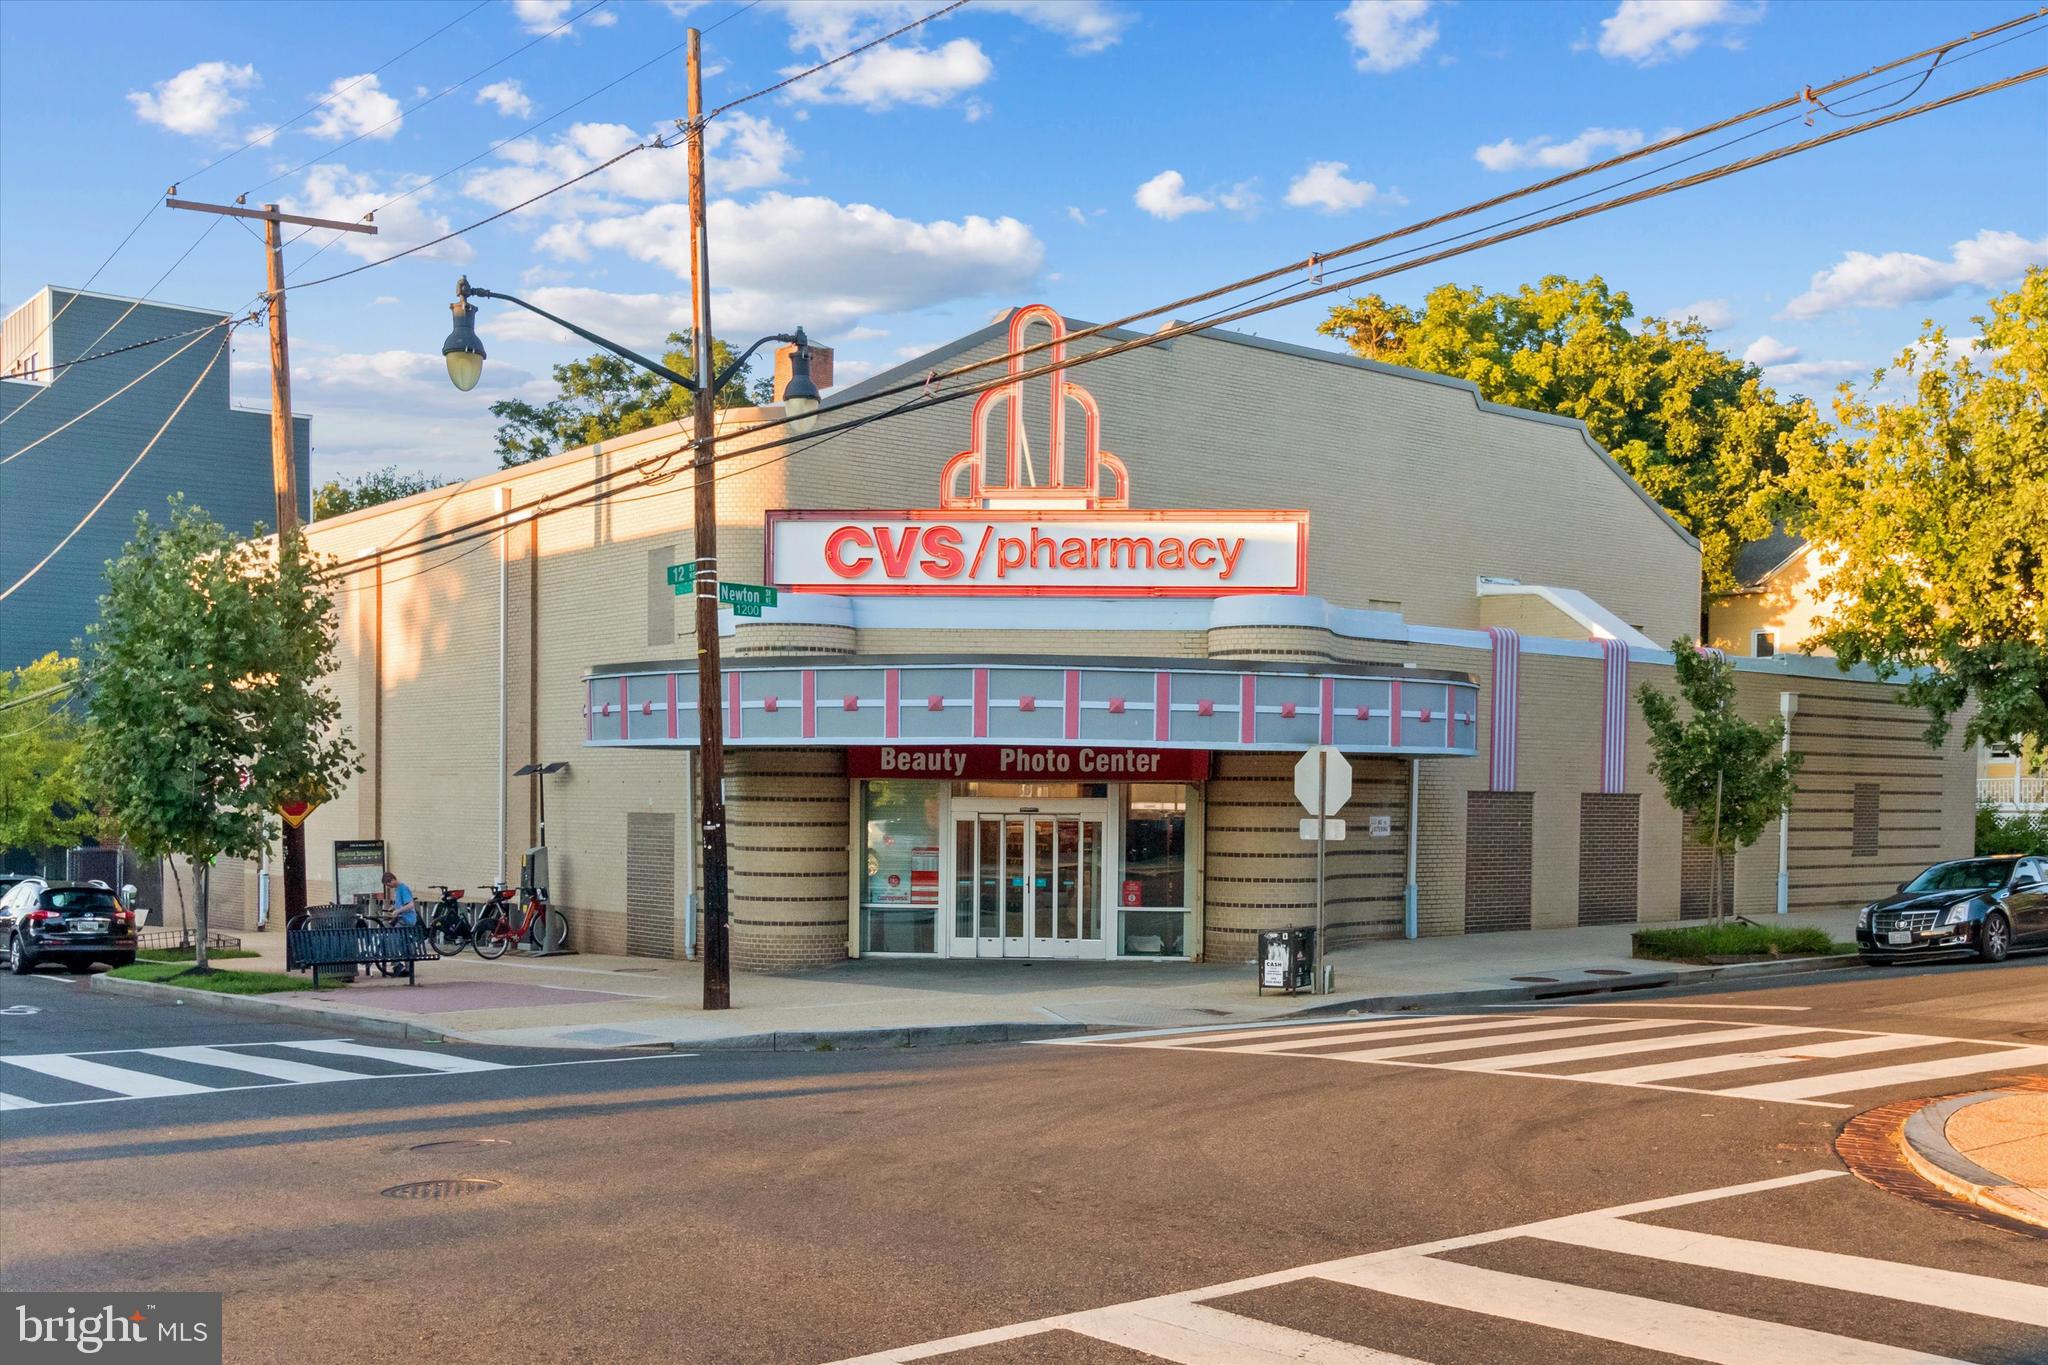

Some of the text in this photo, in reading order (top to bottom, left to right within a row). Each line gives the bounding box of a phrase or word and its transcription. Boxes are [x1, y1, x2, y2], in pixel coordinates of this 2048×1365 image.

[824, 525, 1245, 580] CVS/pharmacy
[672, 566, 685, 582] 12
[721, 584, 760, 603] Newton
[736, 604, 759, 615] 1200
[881, 747, 966, 776] Beauty
[1000, 748, 1160, 773] Photo Center
